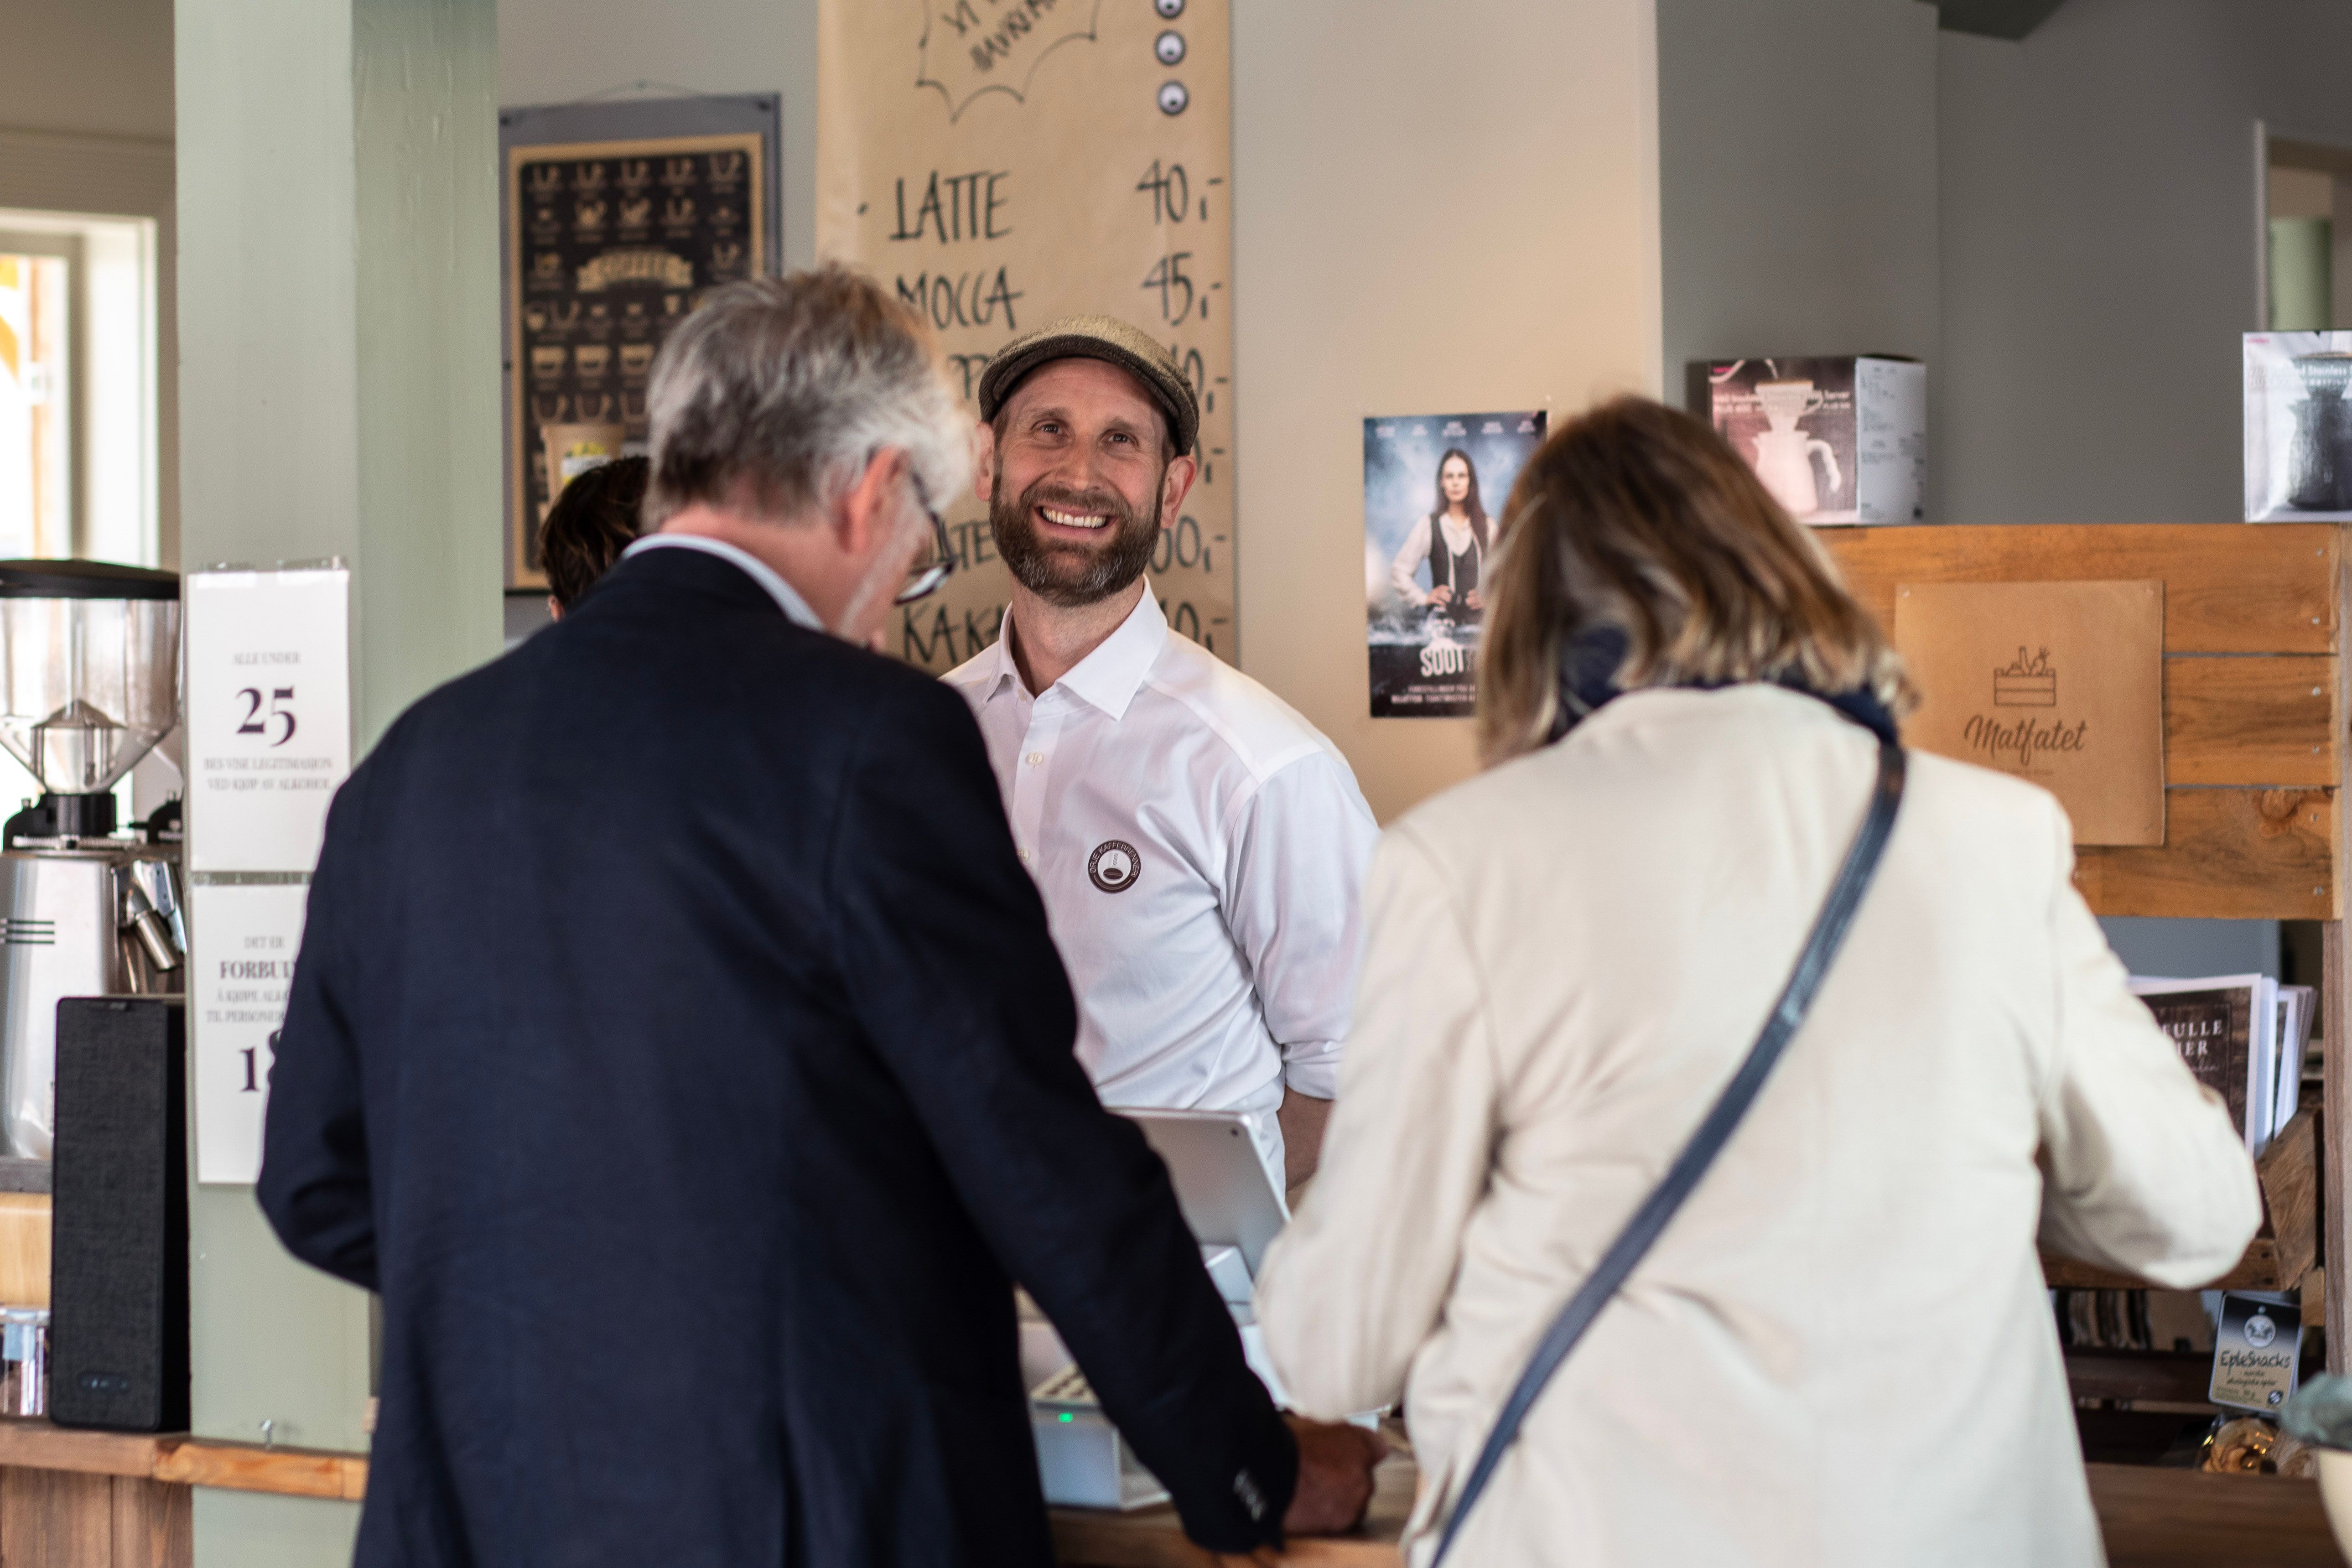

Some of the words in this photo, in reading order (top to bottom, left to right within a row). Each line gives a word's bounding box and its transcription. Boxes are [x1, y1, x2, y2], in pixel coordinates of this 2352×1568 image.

[889, 169, 1013, 244] LATTE
[896, 265, 1024, 330] MOCCA
[233, 652, 259, 665] ALLE
[261, 652, 301, 665] UNDER
[234, 685, 296, 748] 25
[1963, 714, 2087, 766] Matfatet
[2220, 1348, 2291, 1376] EpleSnacks
